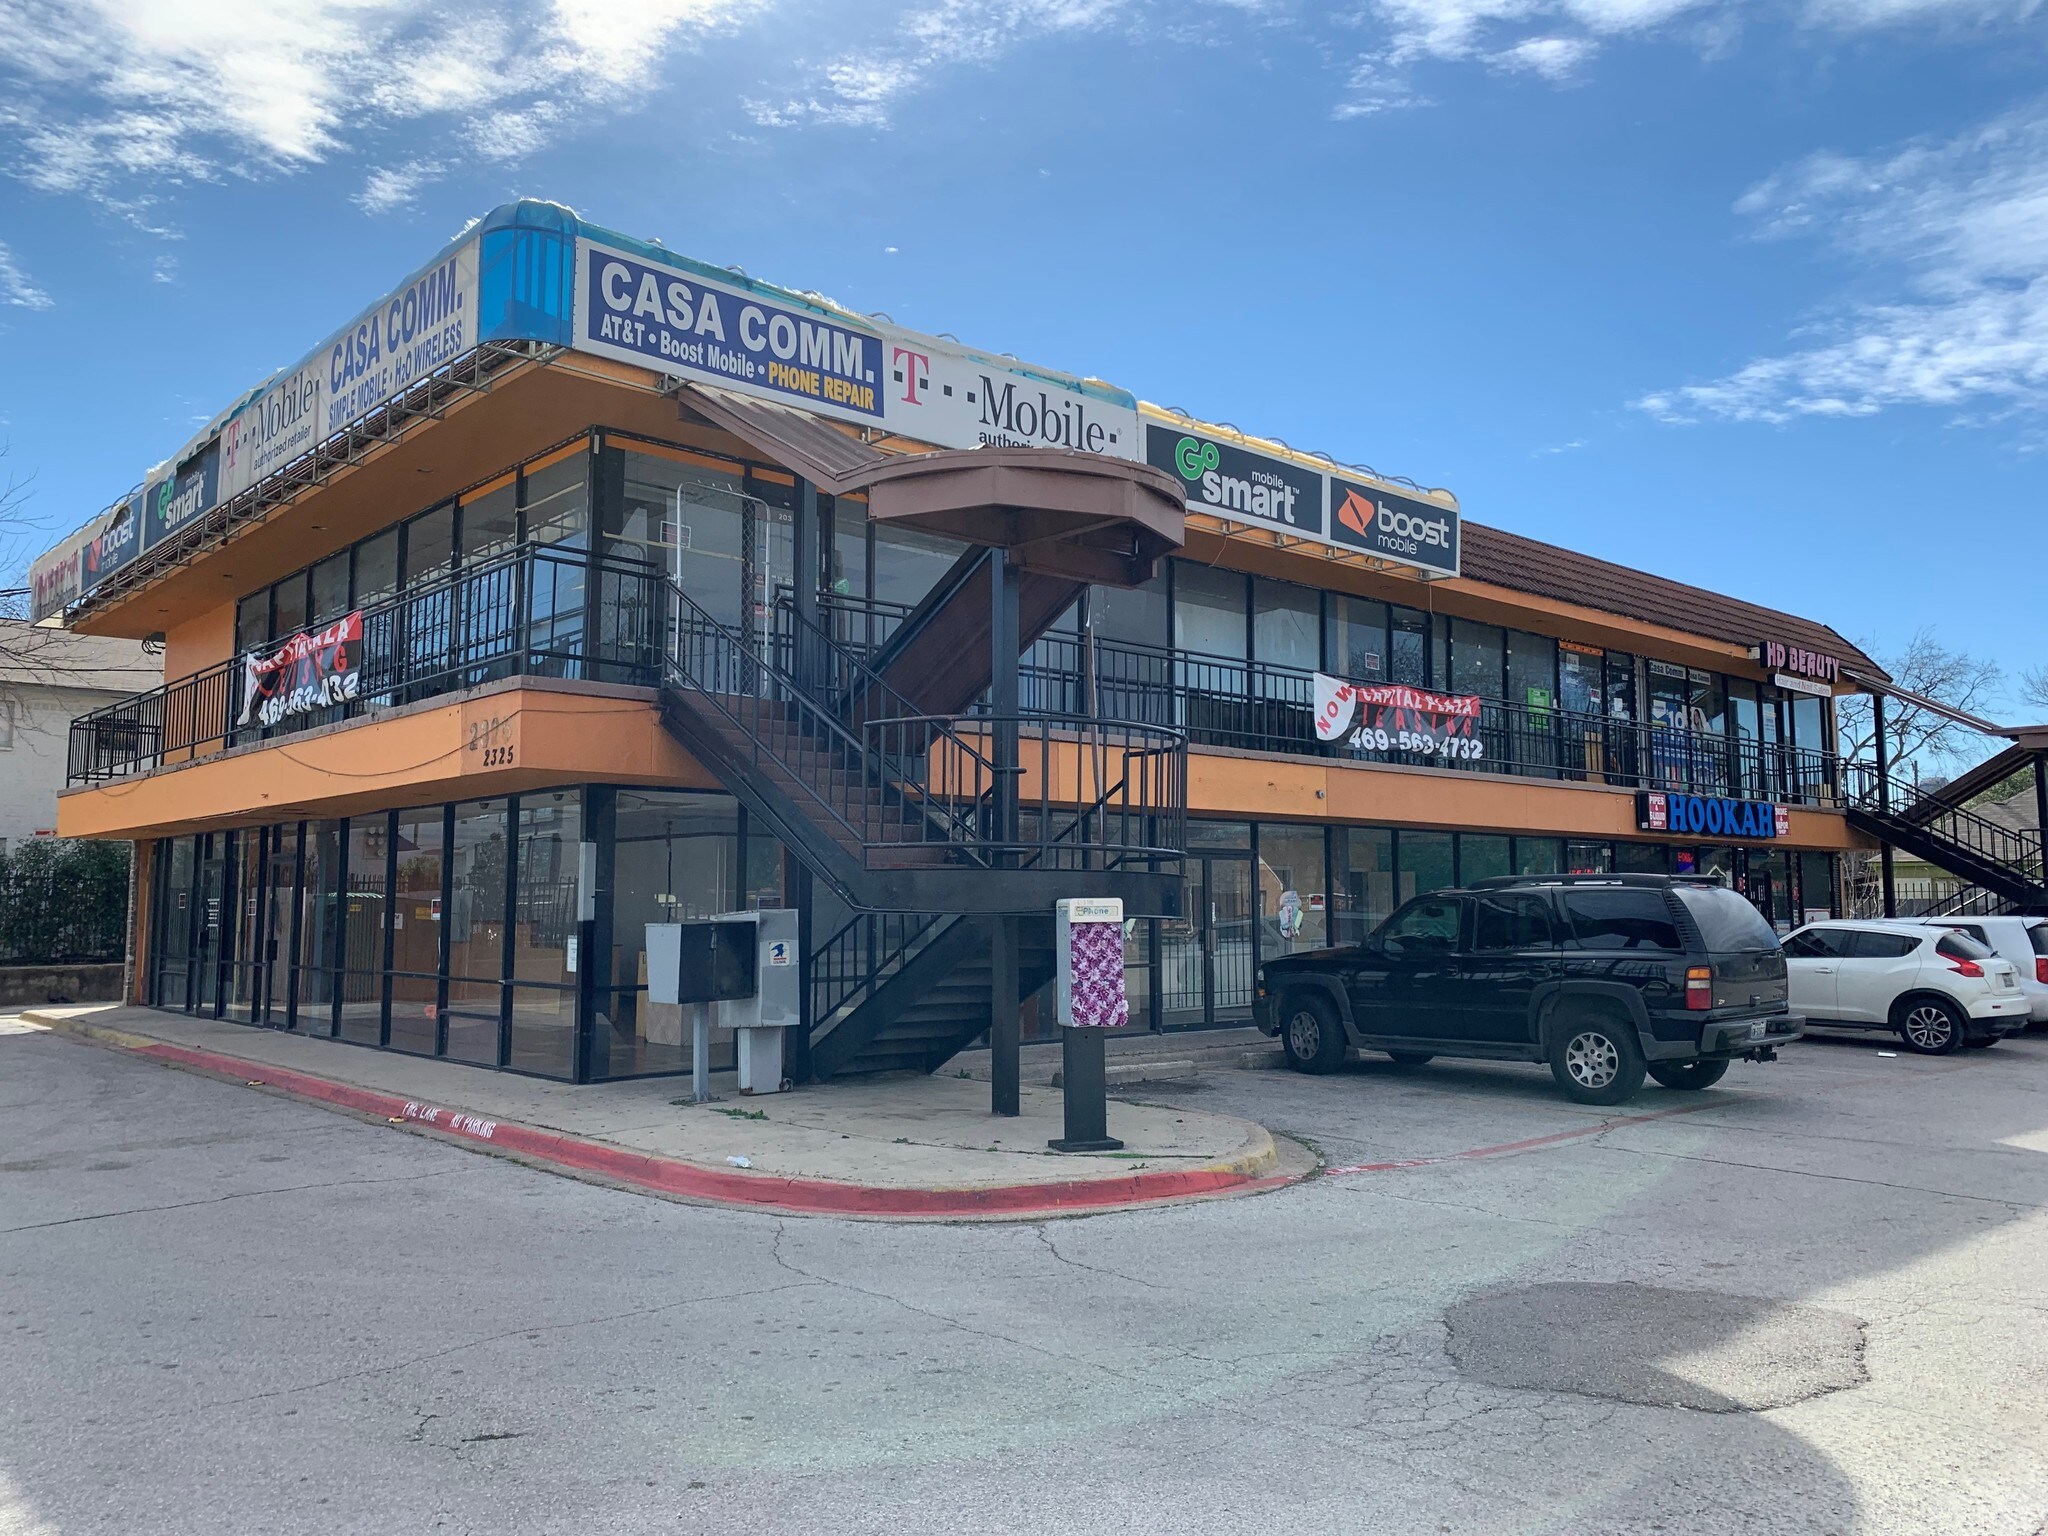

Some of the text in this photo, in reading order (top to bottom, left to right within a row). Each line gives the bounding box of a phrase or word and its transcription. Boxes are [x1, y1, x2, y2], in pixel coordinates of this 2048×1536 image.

[331, 257, 463, 395] CASA COMM.
[601, 262, 875, 384] CASA COMM.
[328, 319, 462, 432] SIMPLE MOBILE H2O WIRELESS
[600, 313, 875, 411] AT&T Boost Mobile PHONE REPAIR
[255, 370, 313, 450] Mobile
[978, 374, 1105, 453] Mobile
[253, 425, 312, 470] authorized retailer
[1175, 436, 1220, 481] Go
[157, 479, 174, 520] Go
[165, 473, 204, 530] smart
[1202, 469, 1295, 524] smart
[1251, 471, 1284, 489] mobile
[778, 513, 792, 522] 203
[1378, 500, 1449, 549] boost
[1378, 534, 1417, 555] mobile
[1766, 640, 1840, 684] HD BEAUTY
[1317, 684, 1354, 735] NOW
[1362, 686, 1473, 715] CAPITAL PLAZA
[1362, 703, 1473, 738] LEASING
[483, 745, 514, 767] 2325
[1349, 727, 1484, 760] 469-563-4732
[1649, 795, 1665, 806] PIPES
[1668, 793, 1775, 837] HOOKAH
[1083, 907, 1109, 915] Phone
[461, 1114, 497, 1139] PARKING
